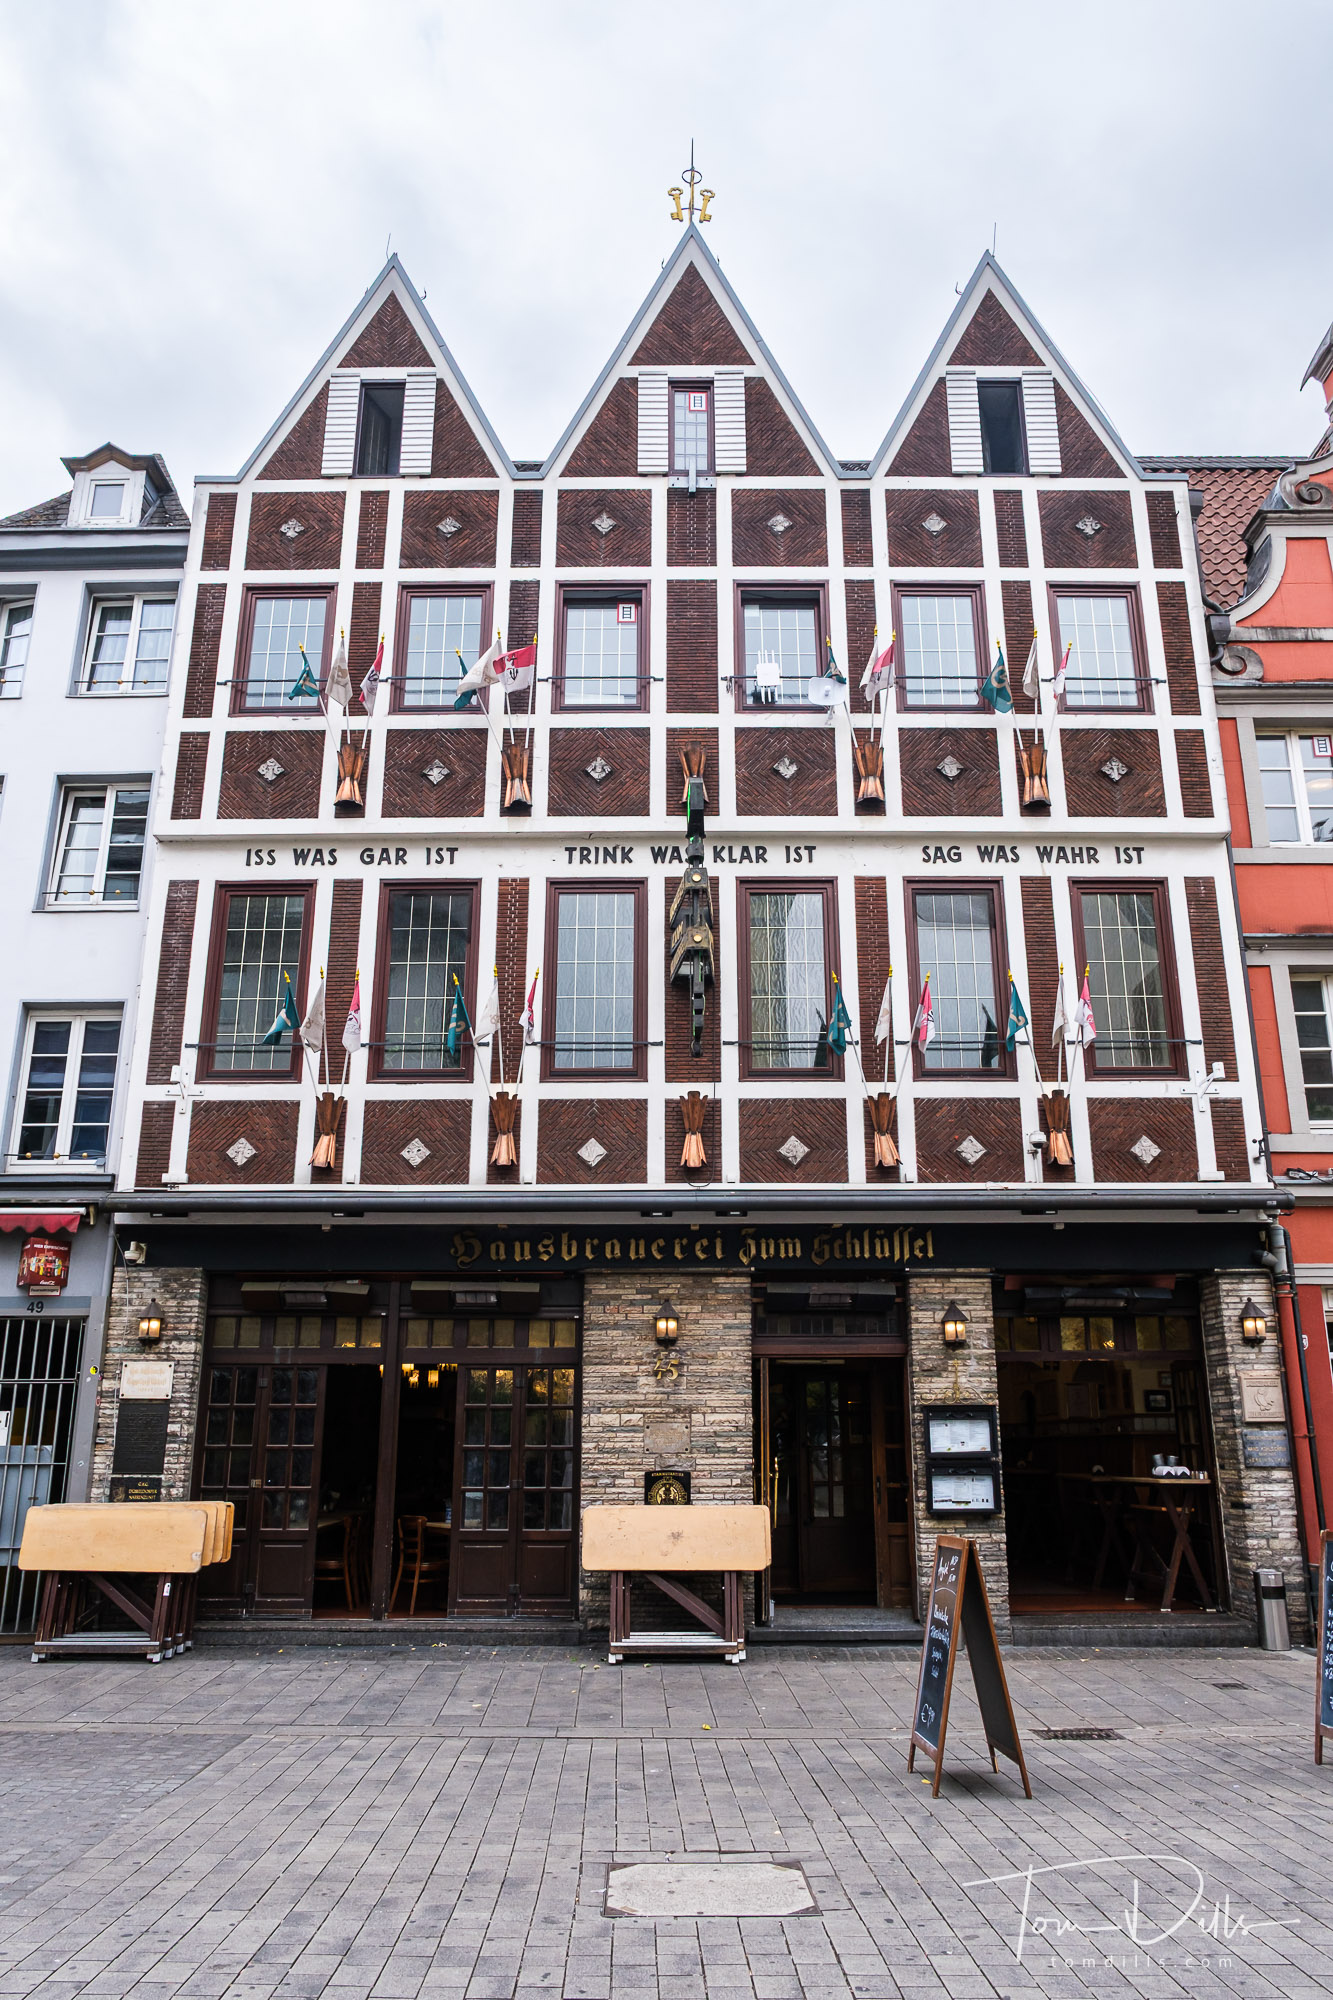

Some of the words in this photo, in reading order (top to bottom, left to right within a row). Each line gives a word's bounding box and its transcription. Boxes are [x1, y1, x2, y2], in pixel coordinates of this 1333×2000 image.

[246, 848, 276, 867] ISS
[292, 848, 338, 867] WAS
[359, 847, 408, 866] GAR
[425, 847, 459, 866] IST
[564, 845, 633, 866] TRINK
[650, 846, 689, 864] WA
[713, 845, 767, 864] KLAR
[784, 845, 816, 864] IST
[921, 845, 962, 864] SAG
[976, 845, 1020, 864] WAS
[1035, 845, 1100, 864] WAHR
[1114, 846, 1146, 865] IST
[450, 1230, 725, 1269] Hausbrauerei
[738, 1227, 802, 1266] Zum
[26, 1301, 44, 1314] 49
[653, 1358, 680, 1380] 45
